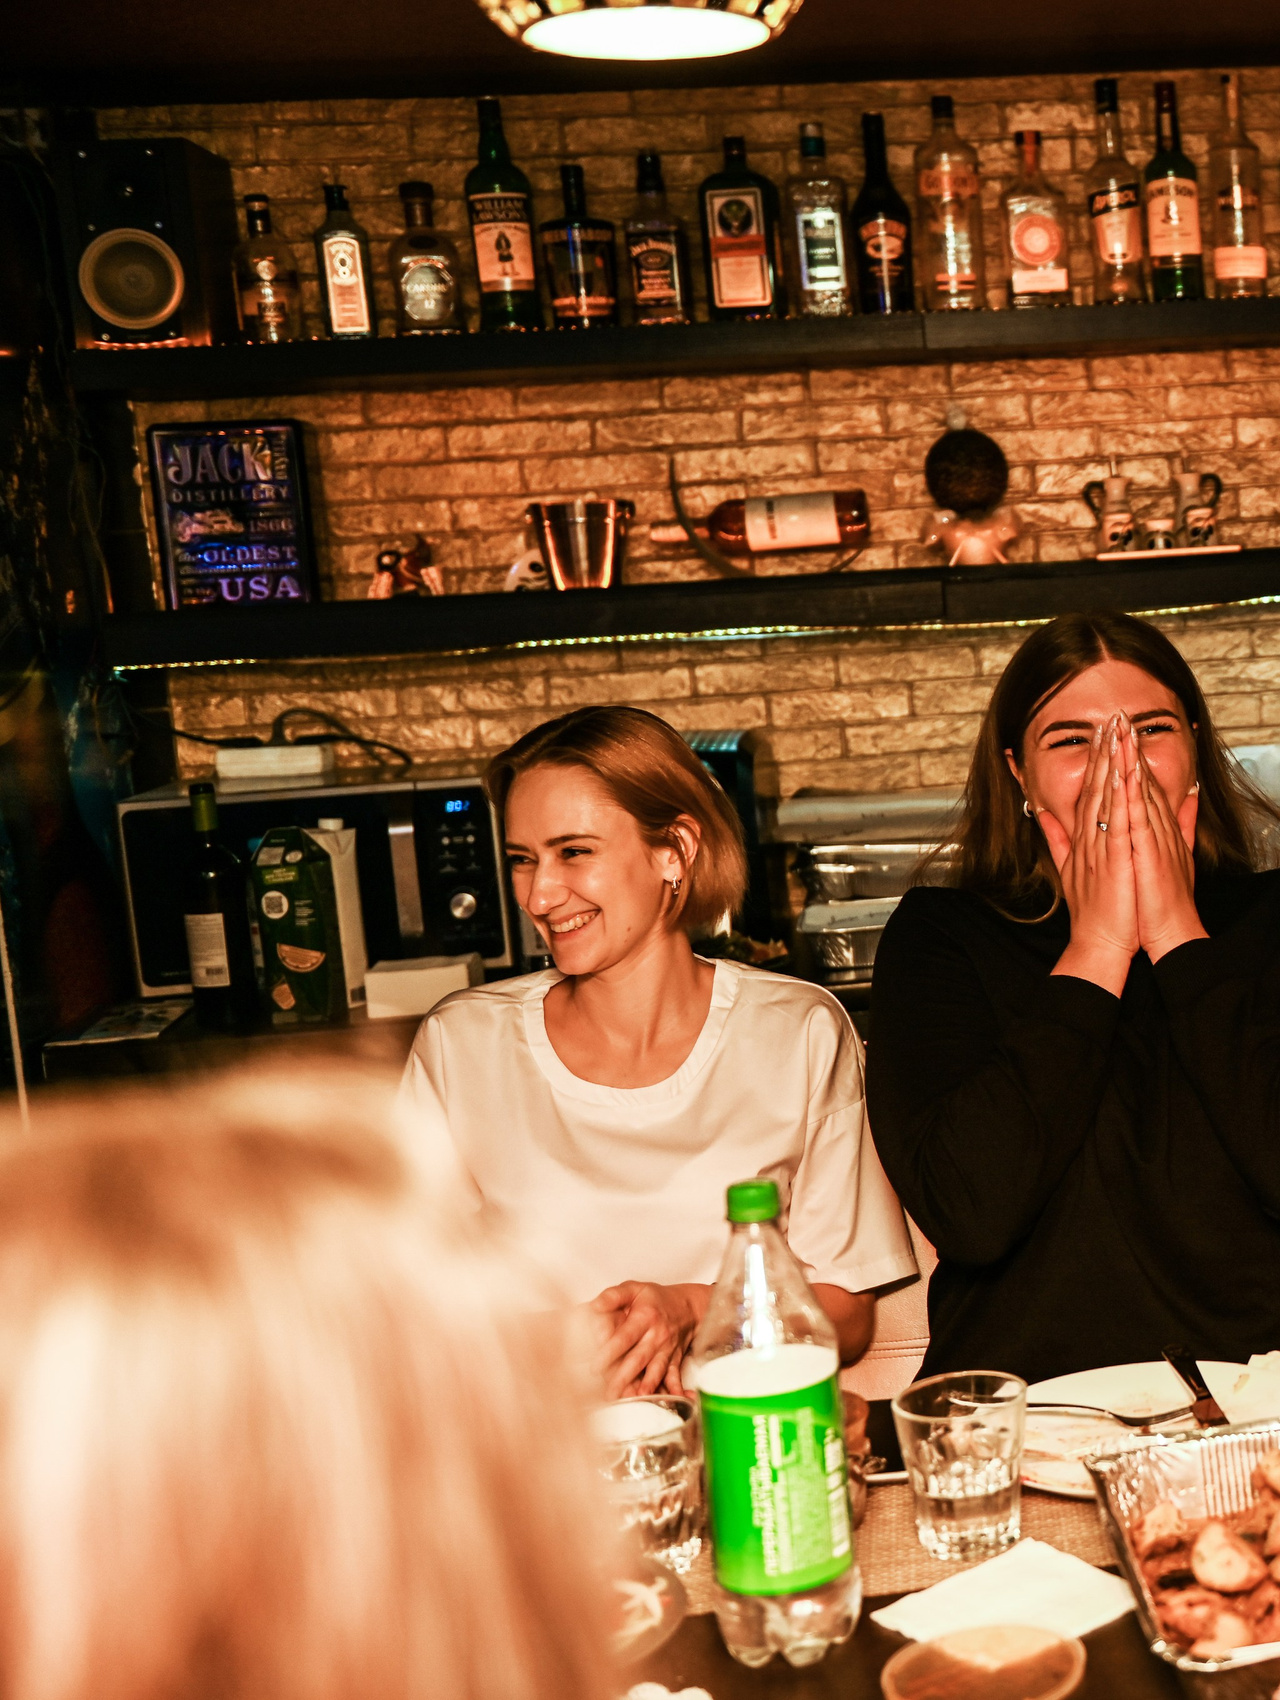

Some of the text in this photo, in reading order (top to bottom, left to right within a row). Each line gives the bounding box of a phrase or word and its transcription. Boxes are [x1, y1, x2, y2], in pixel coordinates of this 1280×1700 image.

[169, 442, 272, 484] JACK
[171, 486, 289, 503] DISTILLERY
[249, 517, 294, 533] 1866
[202, 545, 298, 564] OLDEST
[218, 575, 302, 602] USA
